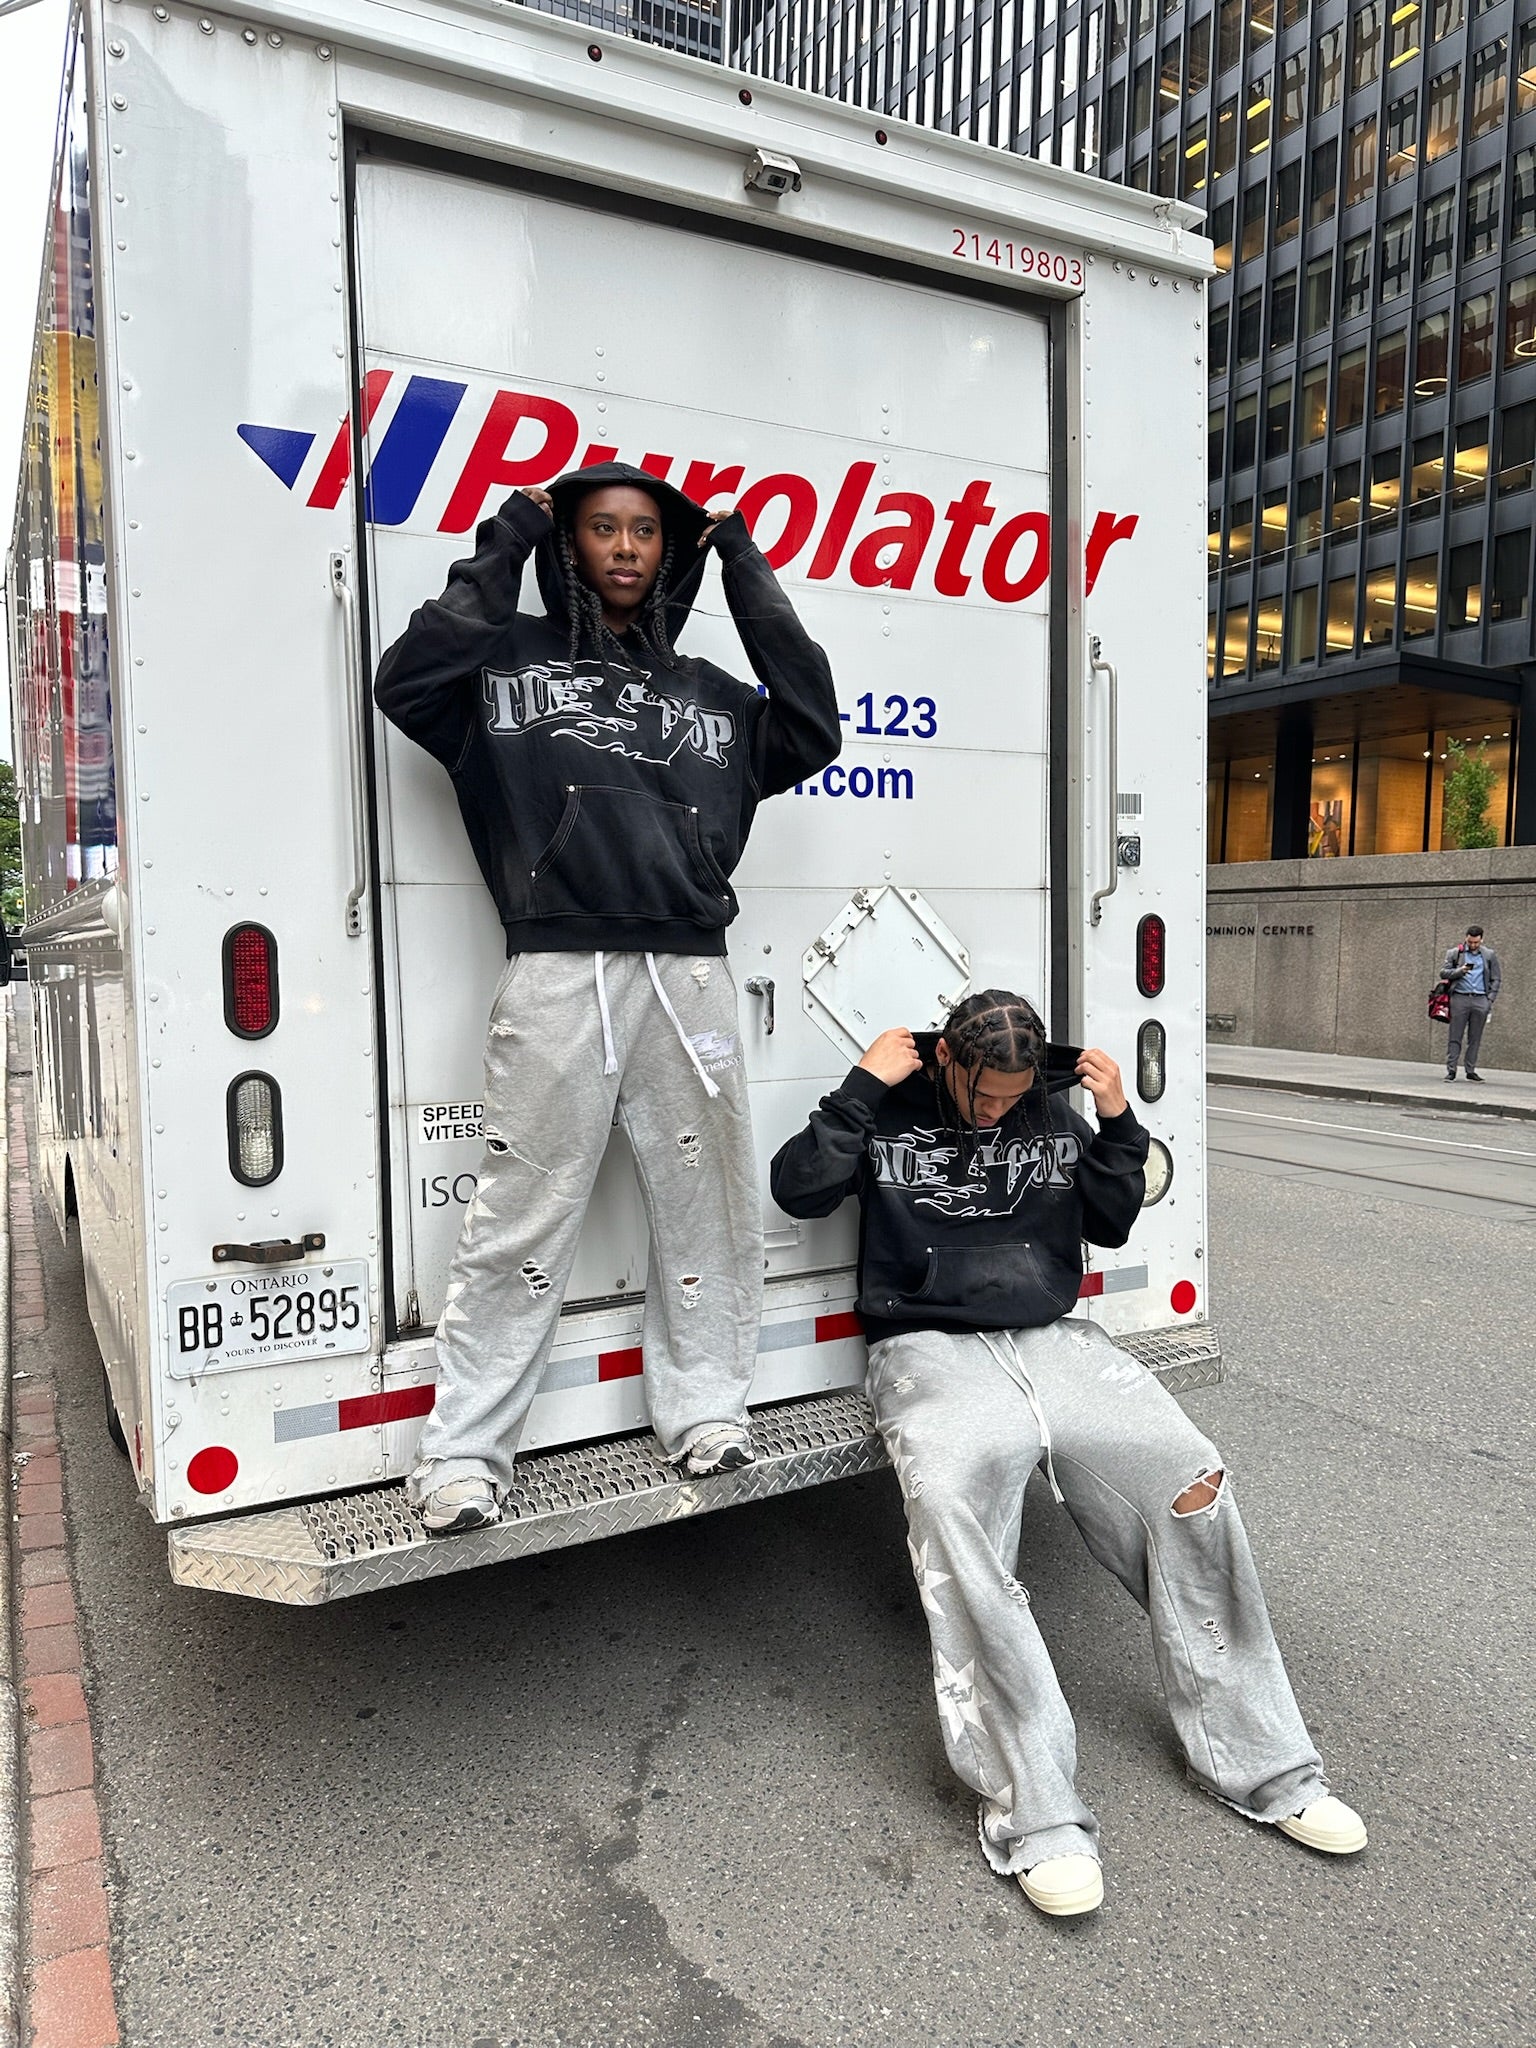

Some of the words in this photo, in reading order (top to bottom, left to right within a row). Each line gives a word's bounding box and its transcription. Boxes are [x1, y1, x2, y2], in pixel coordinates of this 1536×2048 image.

[952, 228, 1082, 286] 21419803
[437, 389, 1140, 603] Prolator
[1206, 925, 1256, 936] OMINION
[1262, 925, 1315, 936] CENTRE
[423, 1104, 484, 1122] SPEED
[231, 1273, 309, 1296] ONTARIO
[179, 1303, 223, 1353] BB
[250, 1285, 360, 1342] 52895
[225, 1347, 255, 1358] YOURS
[259, 1344, 271, 1353] TO
[273, 1337, 318, 1352] DISCOVER
